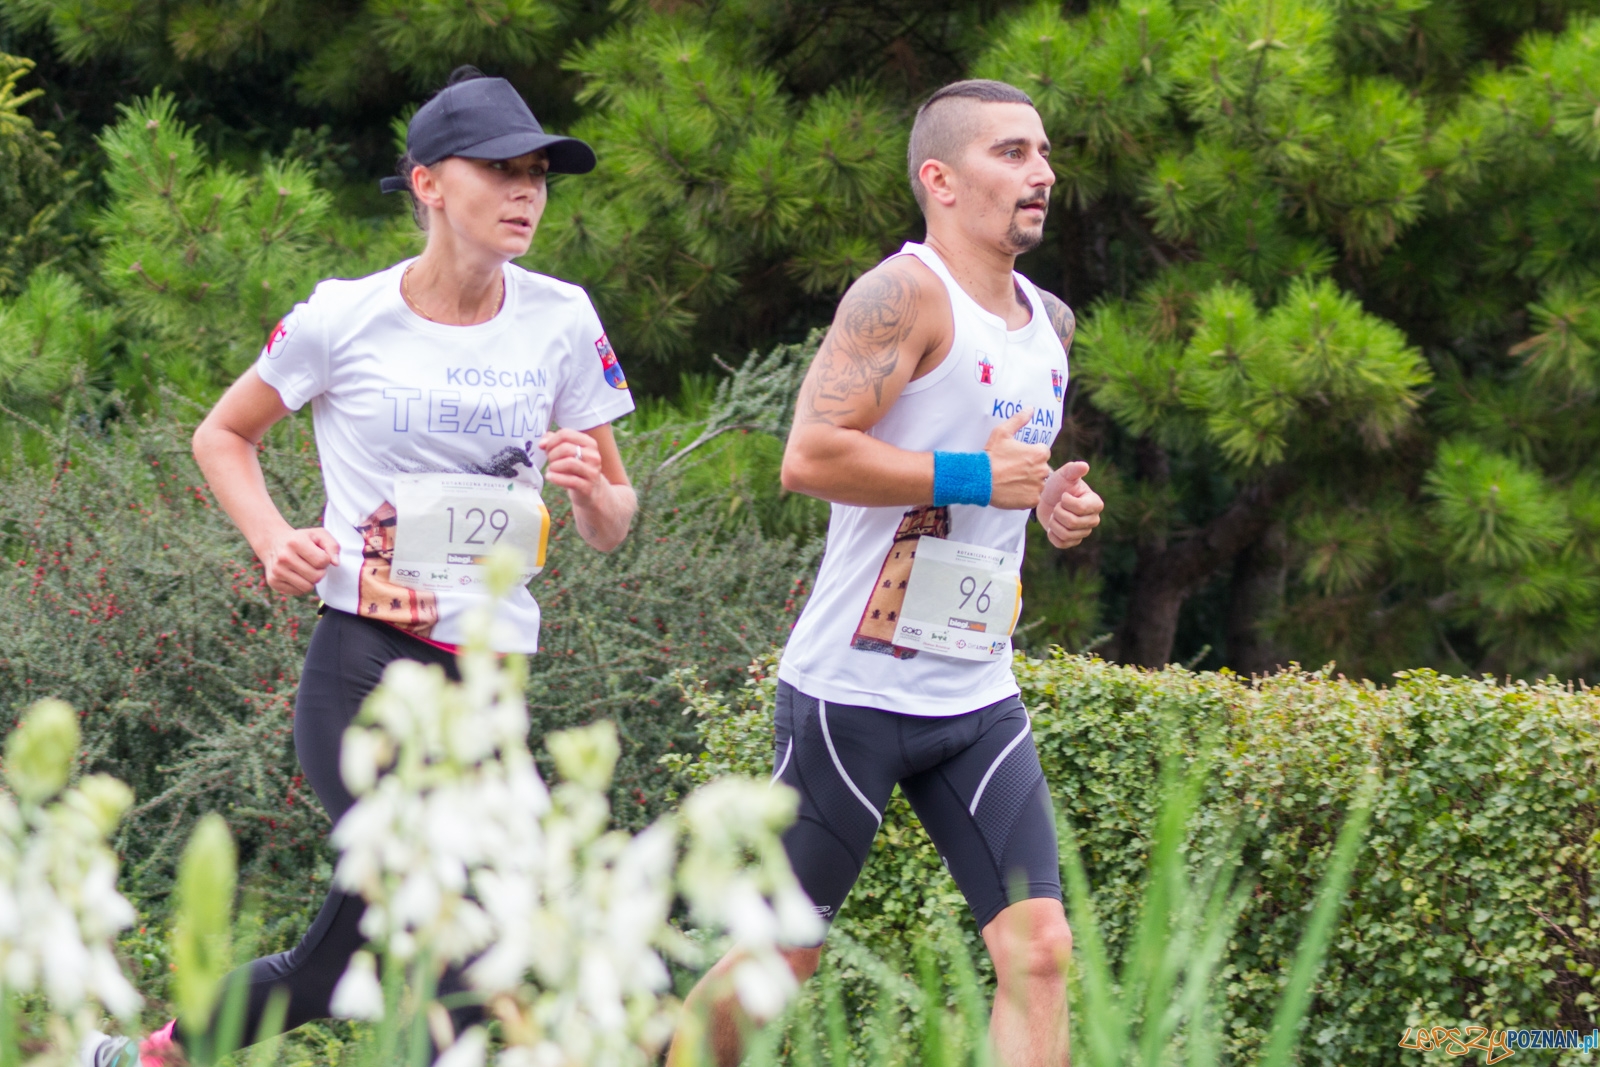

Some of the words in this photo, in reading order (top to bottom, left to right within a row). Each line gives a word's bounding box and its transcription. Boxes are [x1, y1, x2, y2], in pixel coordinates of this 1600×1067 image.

[446, 365, 547, 388] KOŚCIAN
[382, 387, 548, 438] TEAM
[446, 507, 509, 546] 129
[958, 576, 993, 614] 96
